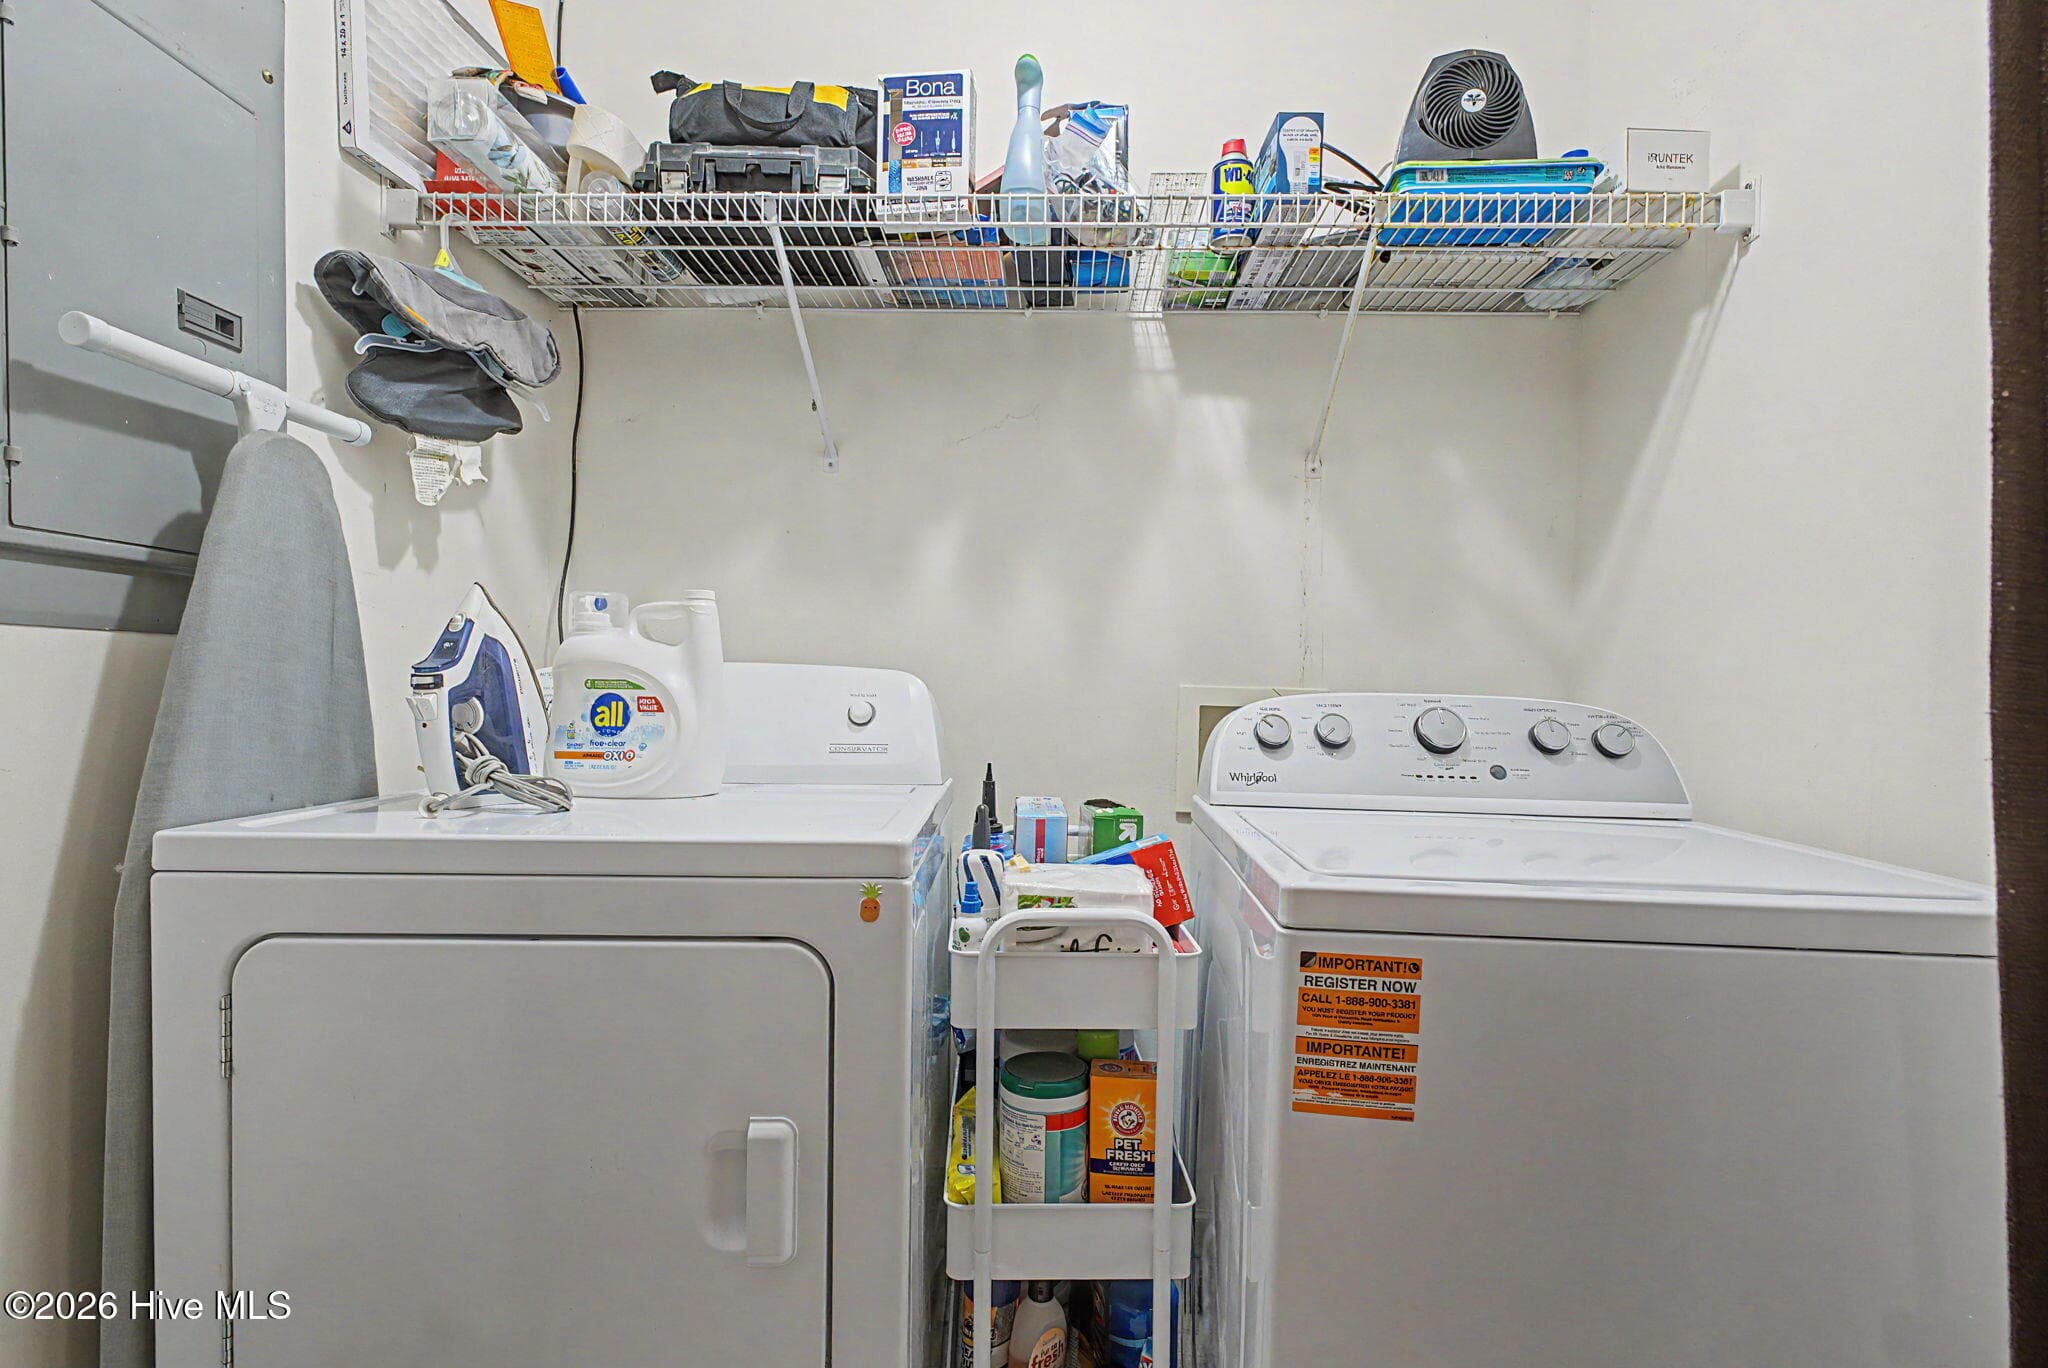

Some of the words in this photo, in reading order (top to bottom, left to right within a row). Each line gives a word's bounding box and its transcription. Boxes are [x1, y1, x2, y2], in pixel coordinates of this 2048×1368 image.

[905, 79, 956, 97] Bona
[1647, 152, 1694, 164] iRUNTEK
[594, 701, 624, 727] all
[1228, 771, 1277, 787] Whirlpool
[1318, 956, 1407, 974] IMPORTANT!
[1303, 975, 1378, 991] REGISTER
[1381, 980, 1418, 993] NOW
[1301, 992, 1332, 1004] CALL
[1335, 995, 1416, 1010] 1-888-900-3381
[1306, 1041, 1406, 1060] IMPORTANTE!
[1296, 1057, 1358, 1069] ENREGISTREZ
[1359, 1062, 1417, 1073] MAINTENANT
[1297, 1069, 1337, 1080] APPELEZ
[1339, 1073, 1351, 1081] LE
[1115, 1139, 1141, 1151] PET
[1106, 1149, 1151, 1162] FRESH
